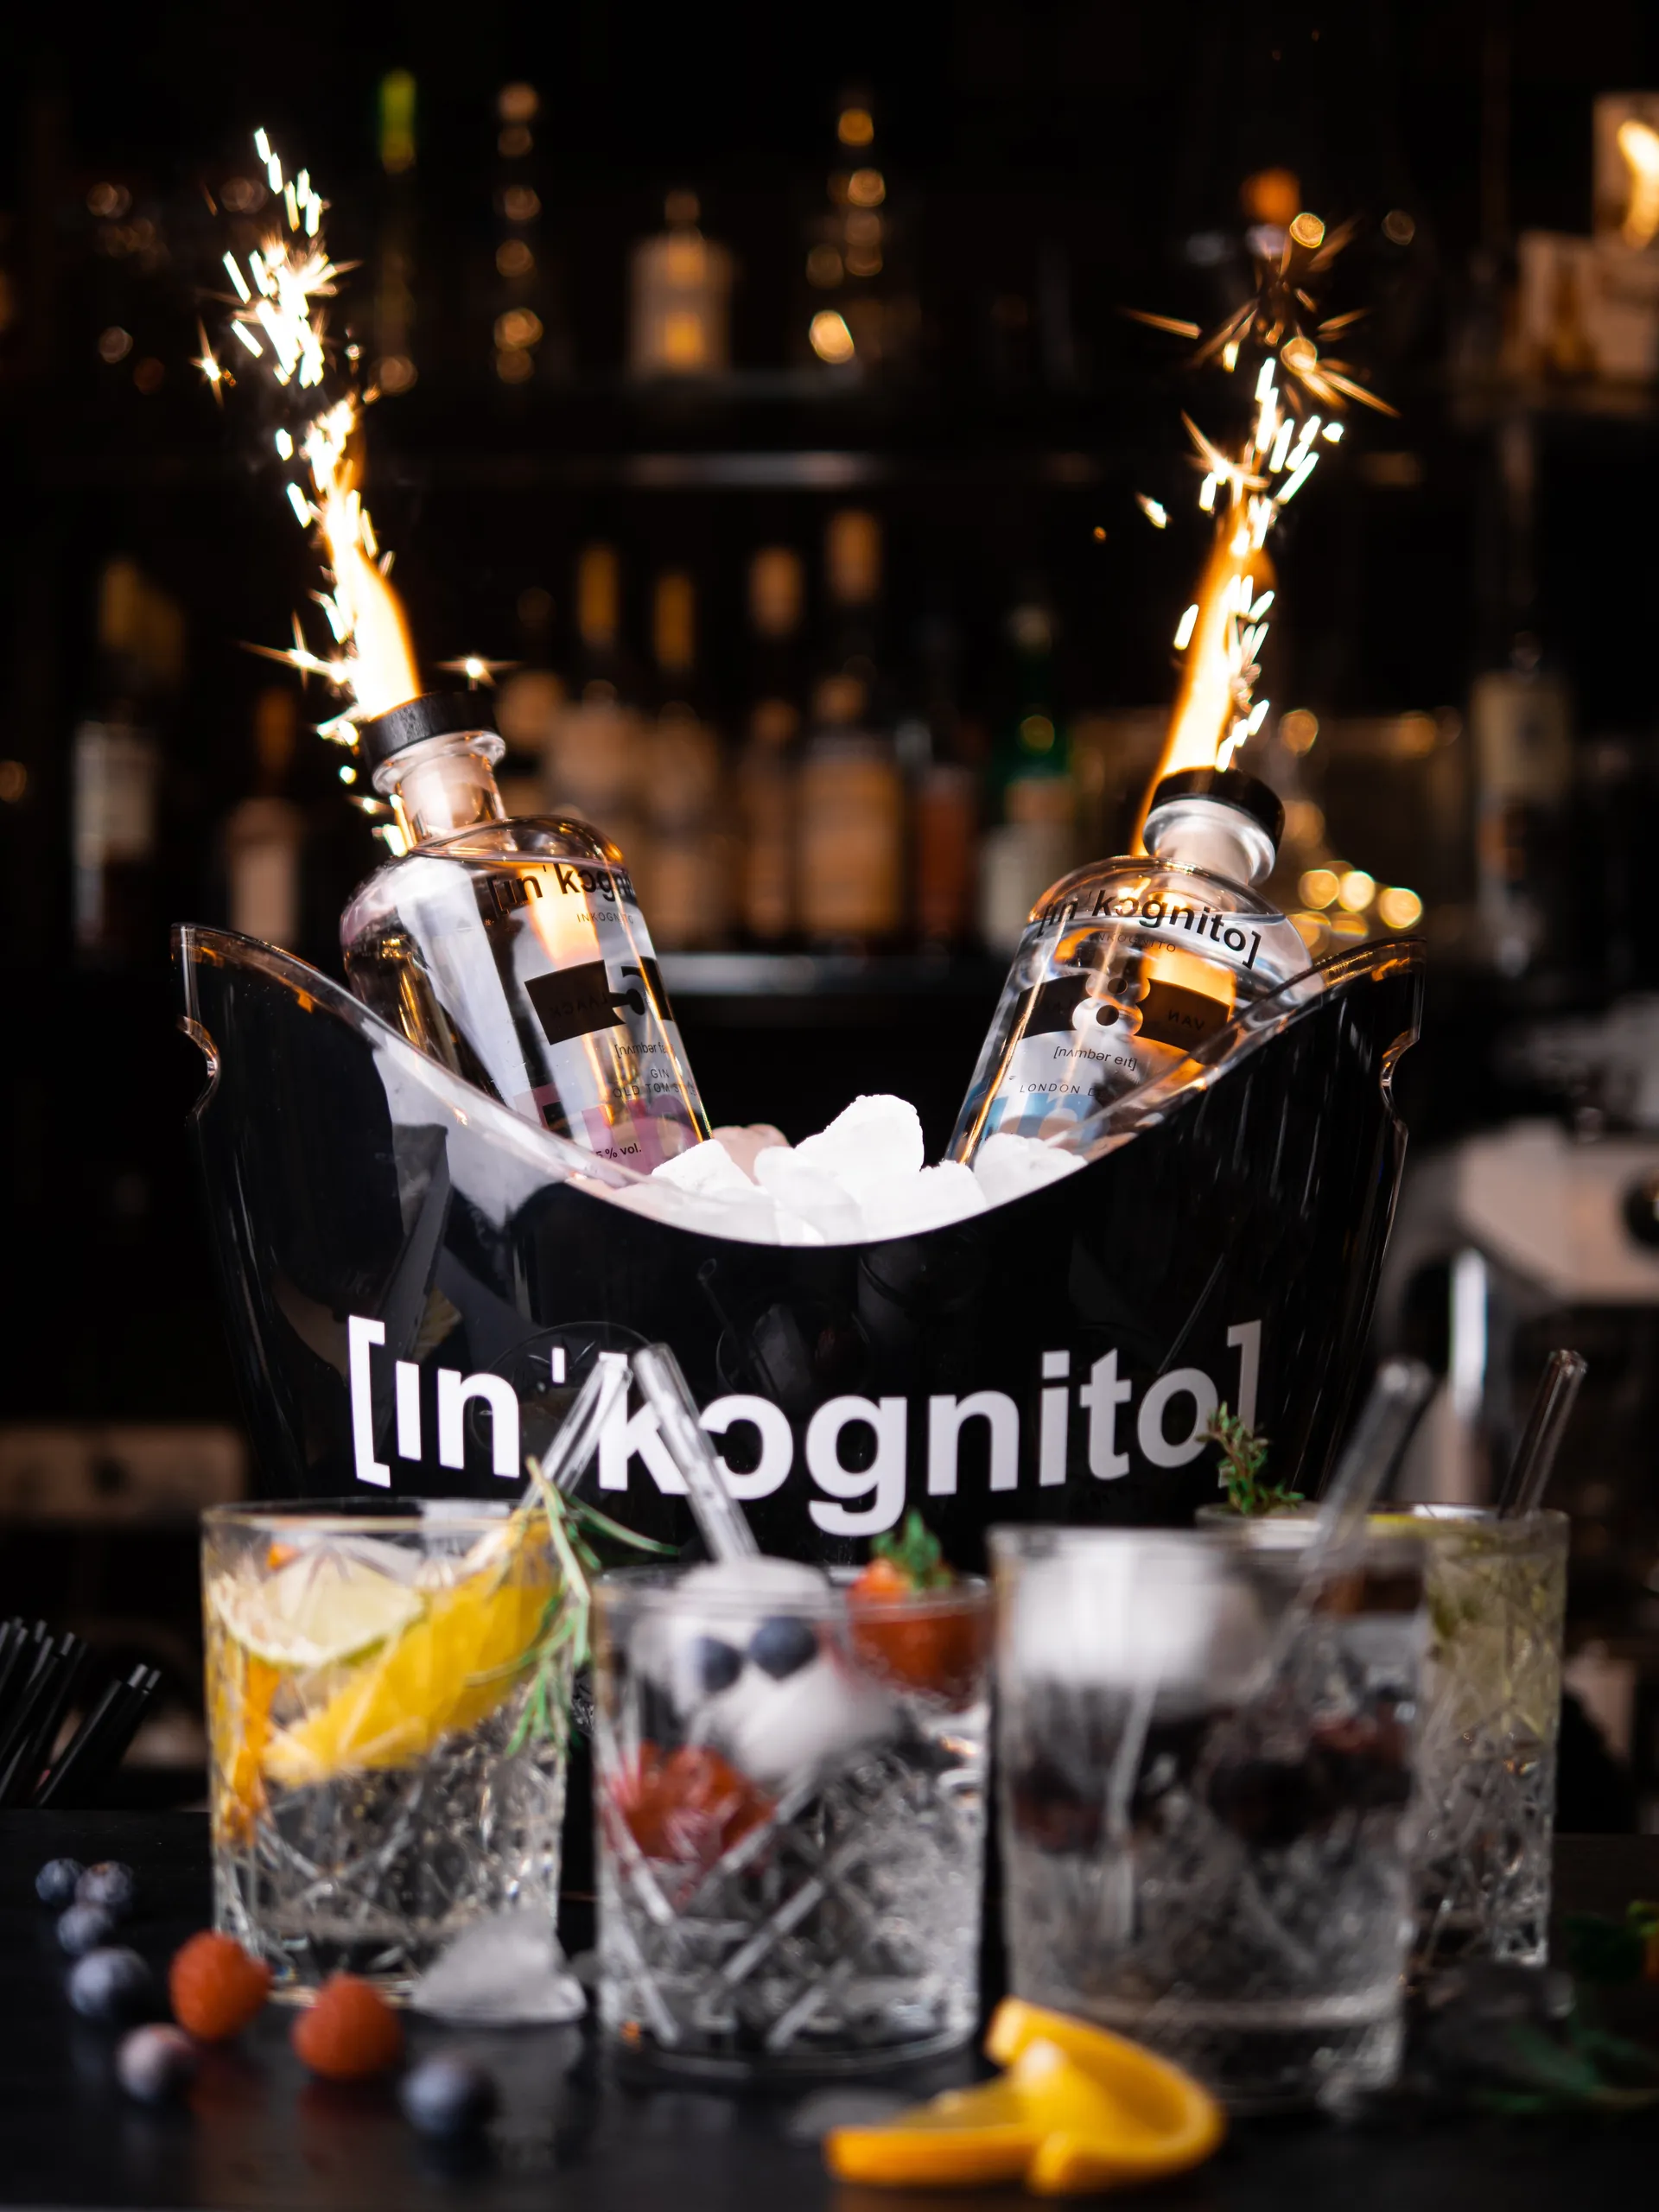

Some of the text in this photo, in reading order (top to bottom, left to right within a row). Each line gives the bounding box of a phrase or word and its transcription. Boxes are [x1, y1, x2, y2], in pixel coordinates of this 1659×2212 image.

[650, 1068, 670, 1079] GIN
[613, 1084, 640, 1098] OLD
[645, 1083, 670, 1095] TOM
[1020, 1083, 1080, 1095] LONDON
[620, 1143, 642, 1156] vol.
